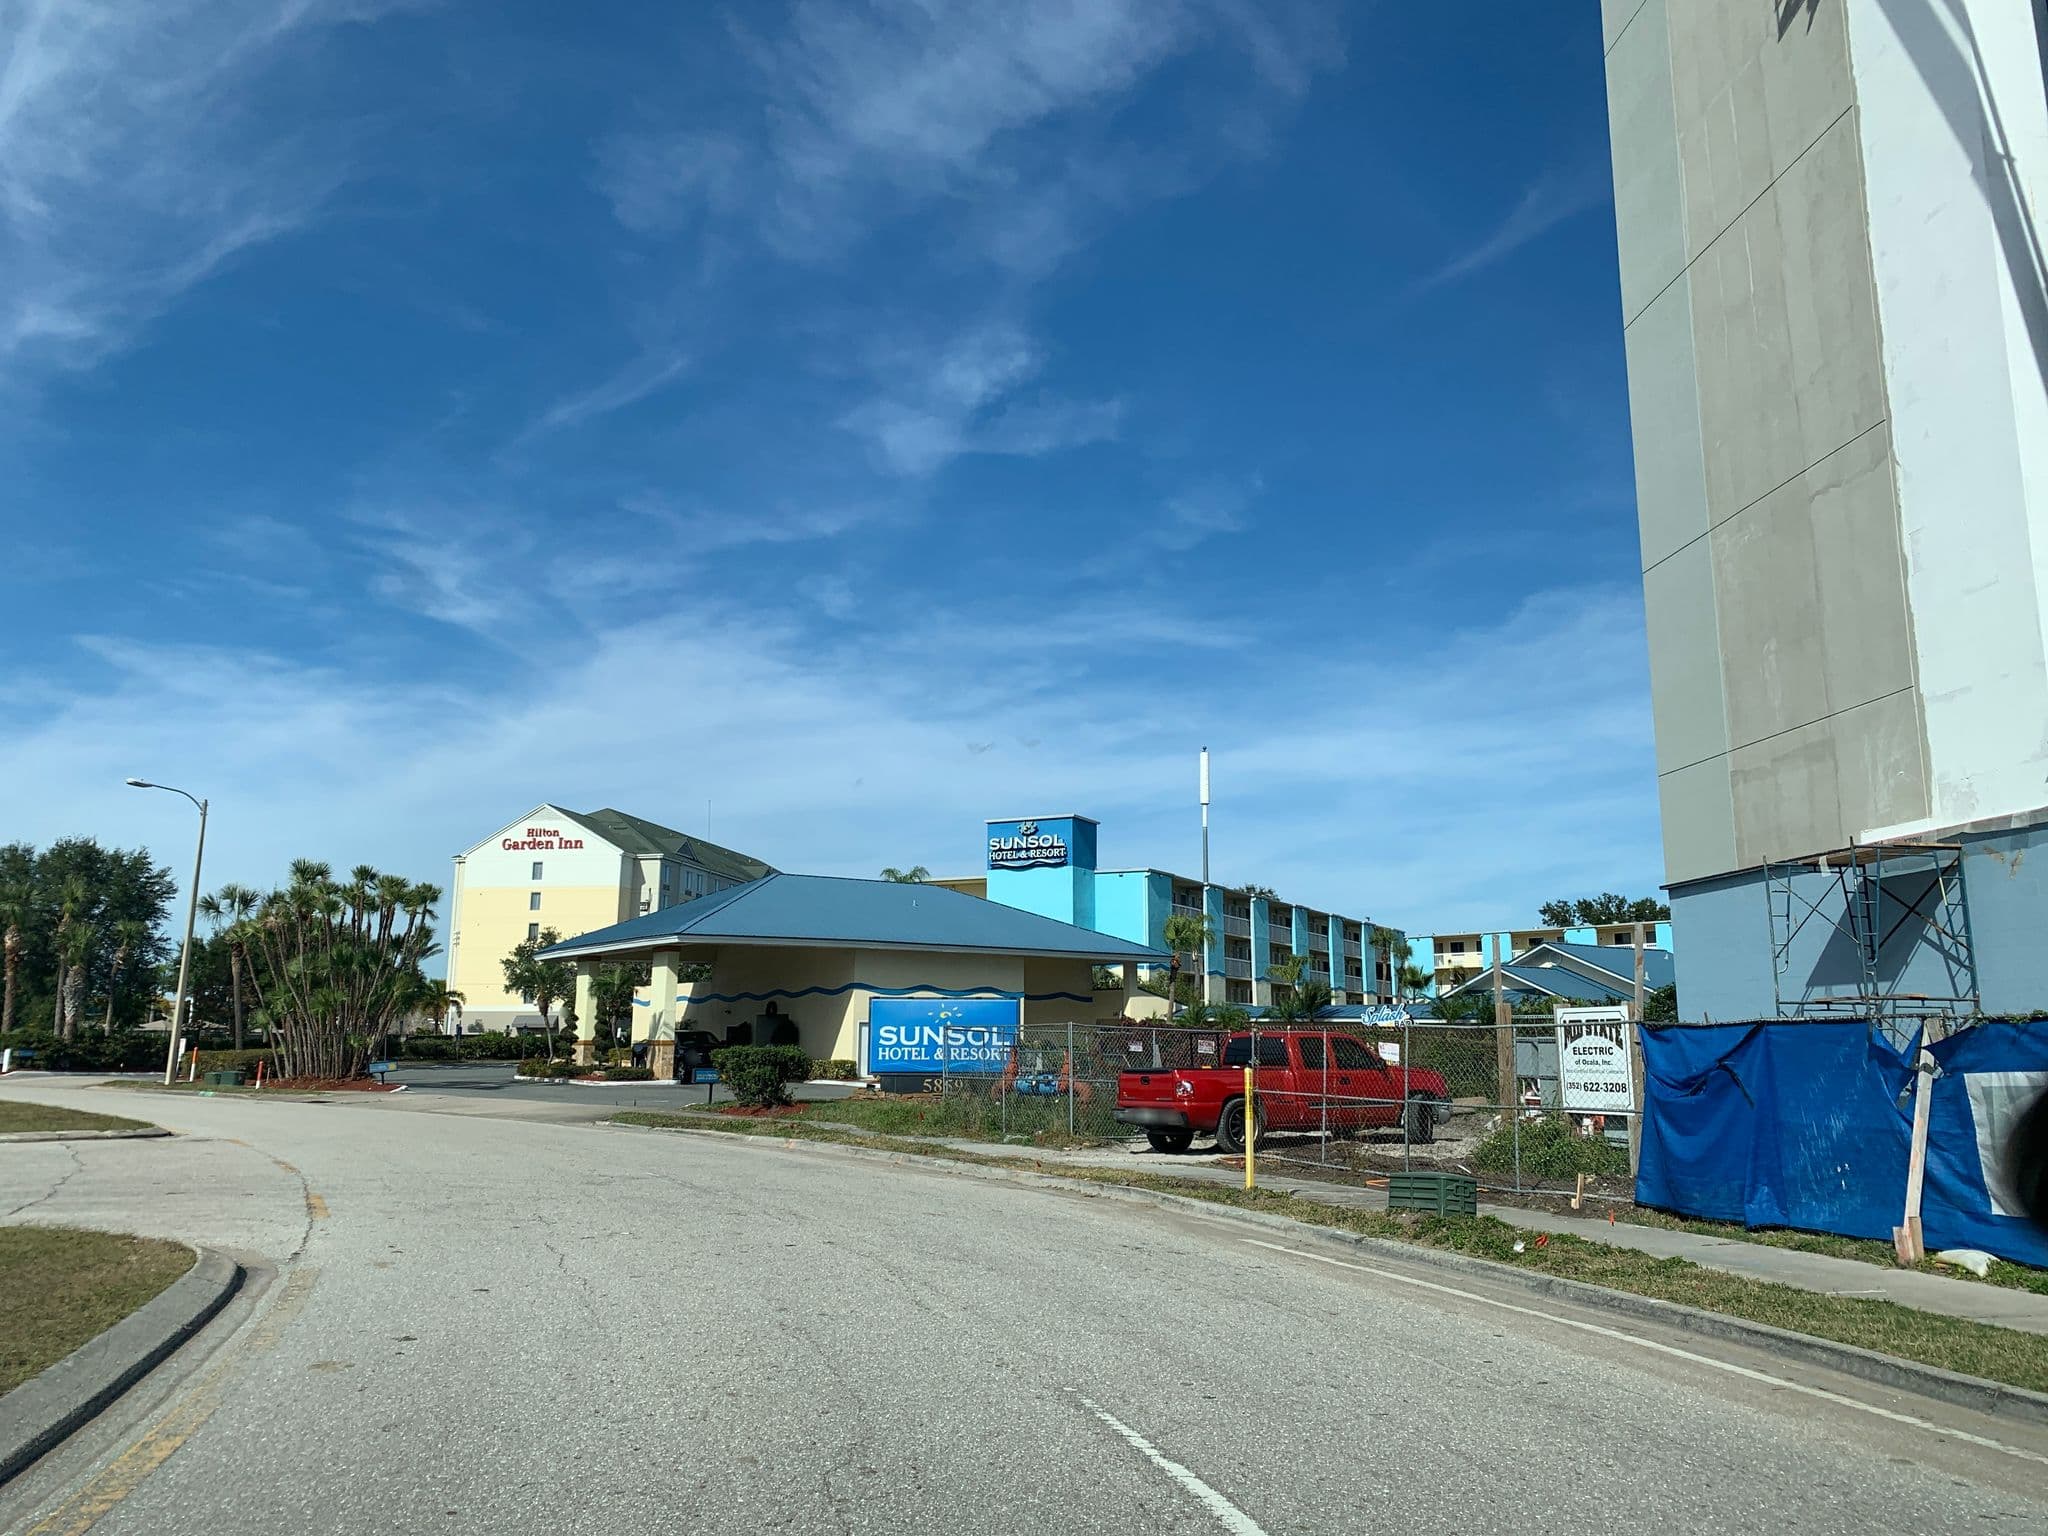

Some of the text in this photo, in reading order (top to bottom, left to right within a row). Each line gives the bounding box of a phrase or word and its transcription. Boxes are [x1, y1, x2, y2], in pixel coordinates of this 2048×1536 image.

[527, 828, 559, 838] Hilton
[502, 837, 583, 850] Garden Inn
[989, 834, 1065, 850] SUNSOL
[988, 848, 1065, 860] HOTEL & RESORT
[1361, 1003, 1410, 1027] Splash
[879, 1025, 1010, 1046] SUNSOL
[1585, 1018, 1623, 1050] STATE
[878, 1047, 1010, 1061] HOTEL & RESORT
[1573, 1046, 1614, 1056] ELECTRIC
[1575, 1058, 1613, 1067] of Ocala, Inc.
[1566, 1082, 1627, 1094] (352) 622-3208
